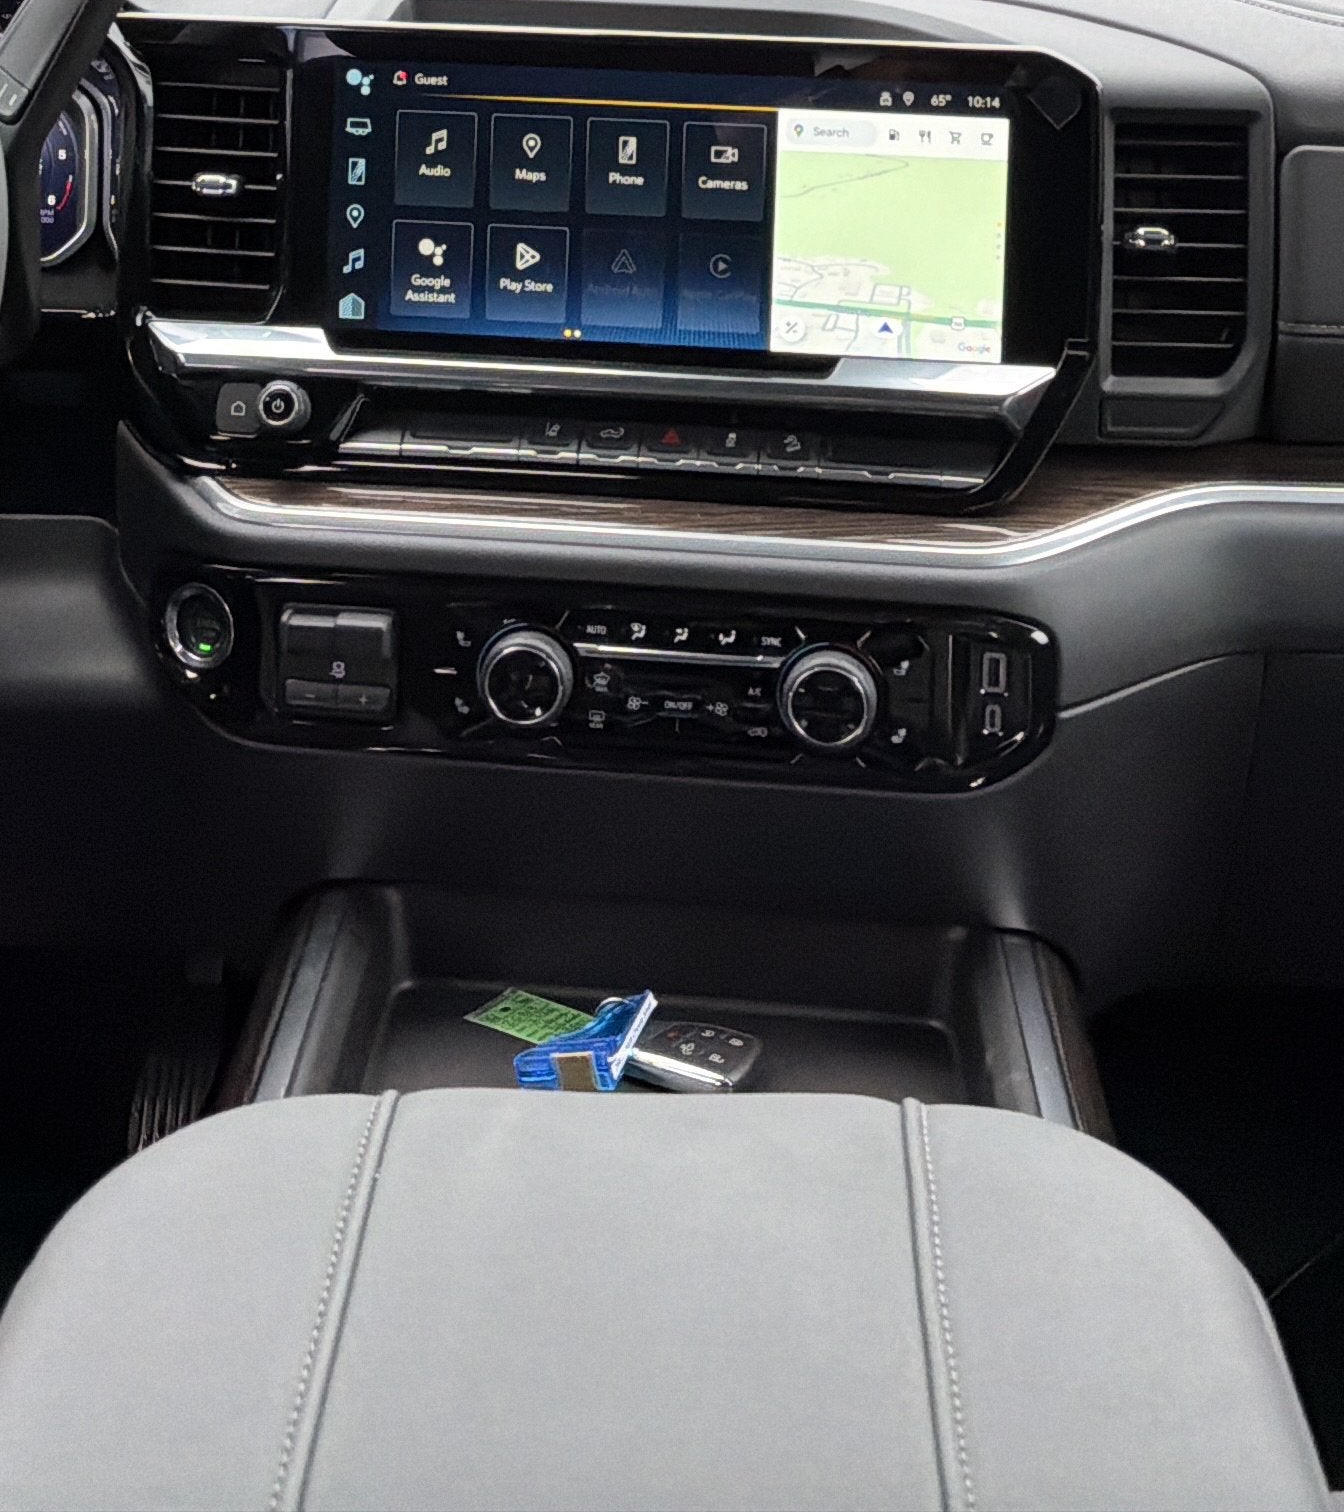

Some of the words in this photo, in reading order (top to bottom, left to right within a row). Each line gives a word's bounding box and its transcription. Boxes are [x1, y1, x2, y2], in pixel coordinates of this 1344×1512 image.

[414, 73, 449, 86] Guest
[967, 95, 1001, 109] 10:14
[813, 126, 850, 139] Search
[58, 149, 67, 160] 5
[418, 164, 451, 177] Audio
[514, 168, 547, 183] Maps
[608, 172, 645, 186] Phone
[698, 176, 749, 191] Cameras
[47, 194, 56, 206] 6
[410, 273, 451, 289] Google
[499, 277, 522, 294] Play
[524, 279, 554, 293] Store
[405, 289, 456, 304] Assistant
[957, 341, 991, 355] Google
[586, 624, 607, 635] AUTO
[761, 636, 782, 647] SYNC
[664, 700, 694, 711] ON/OFF
